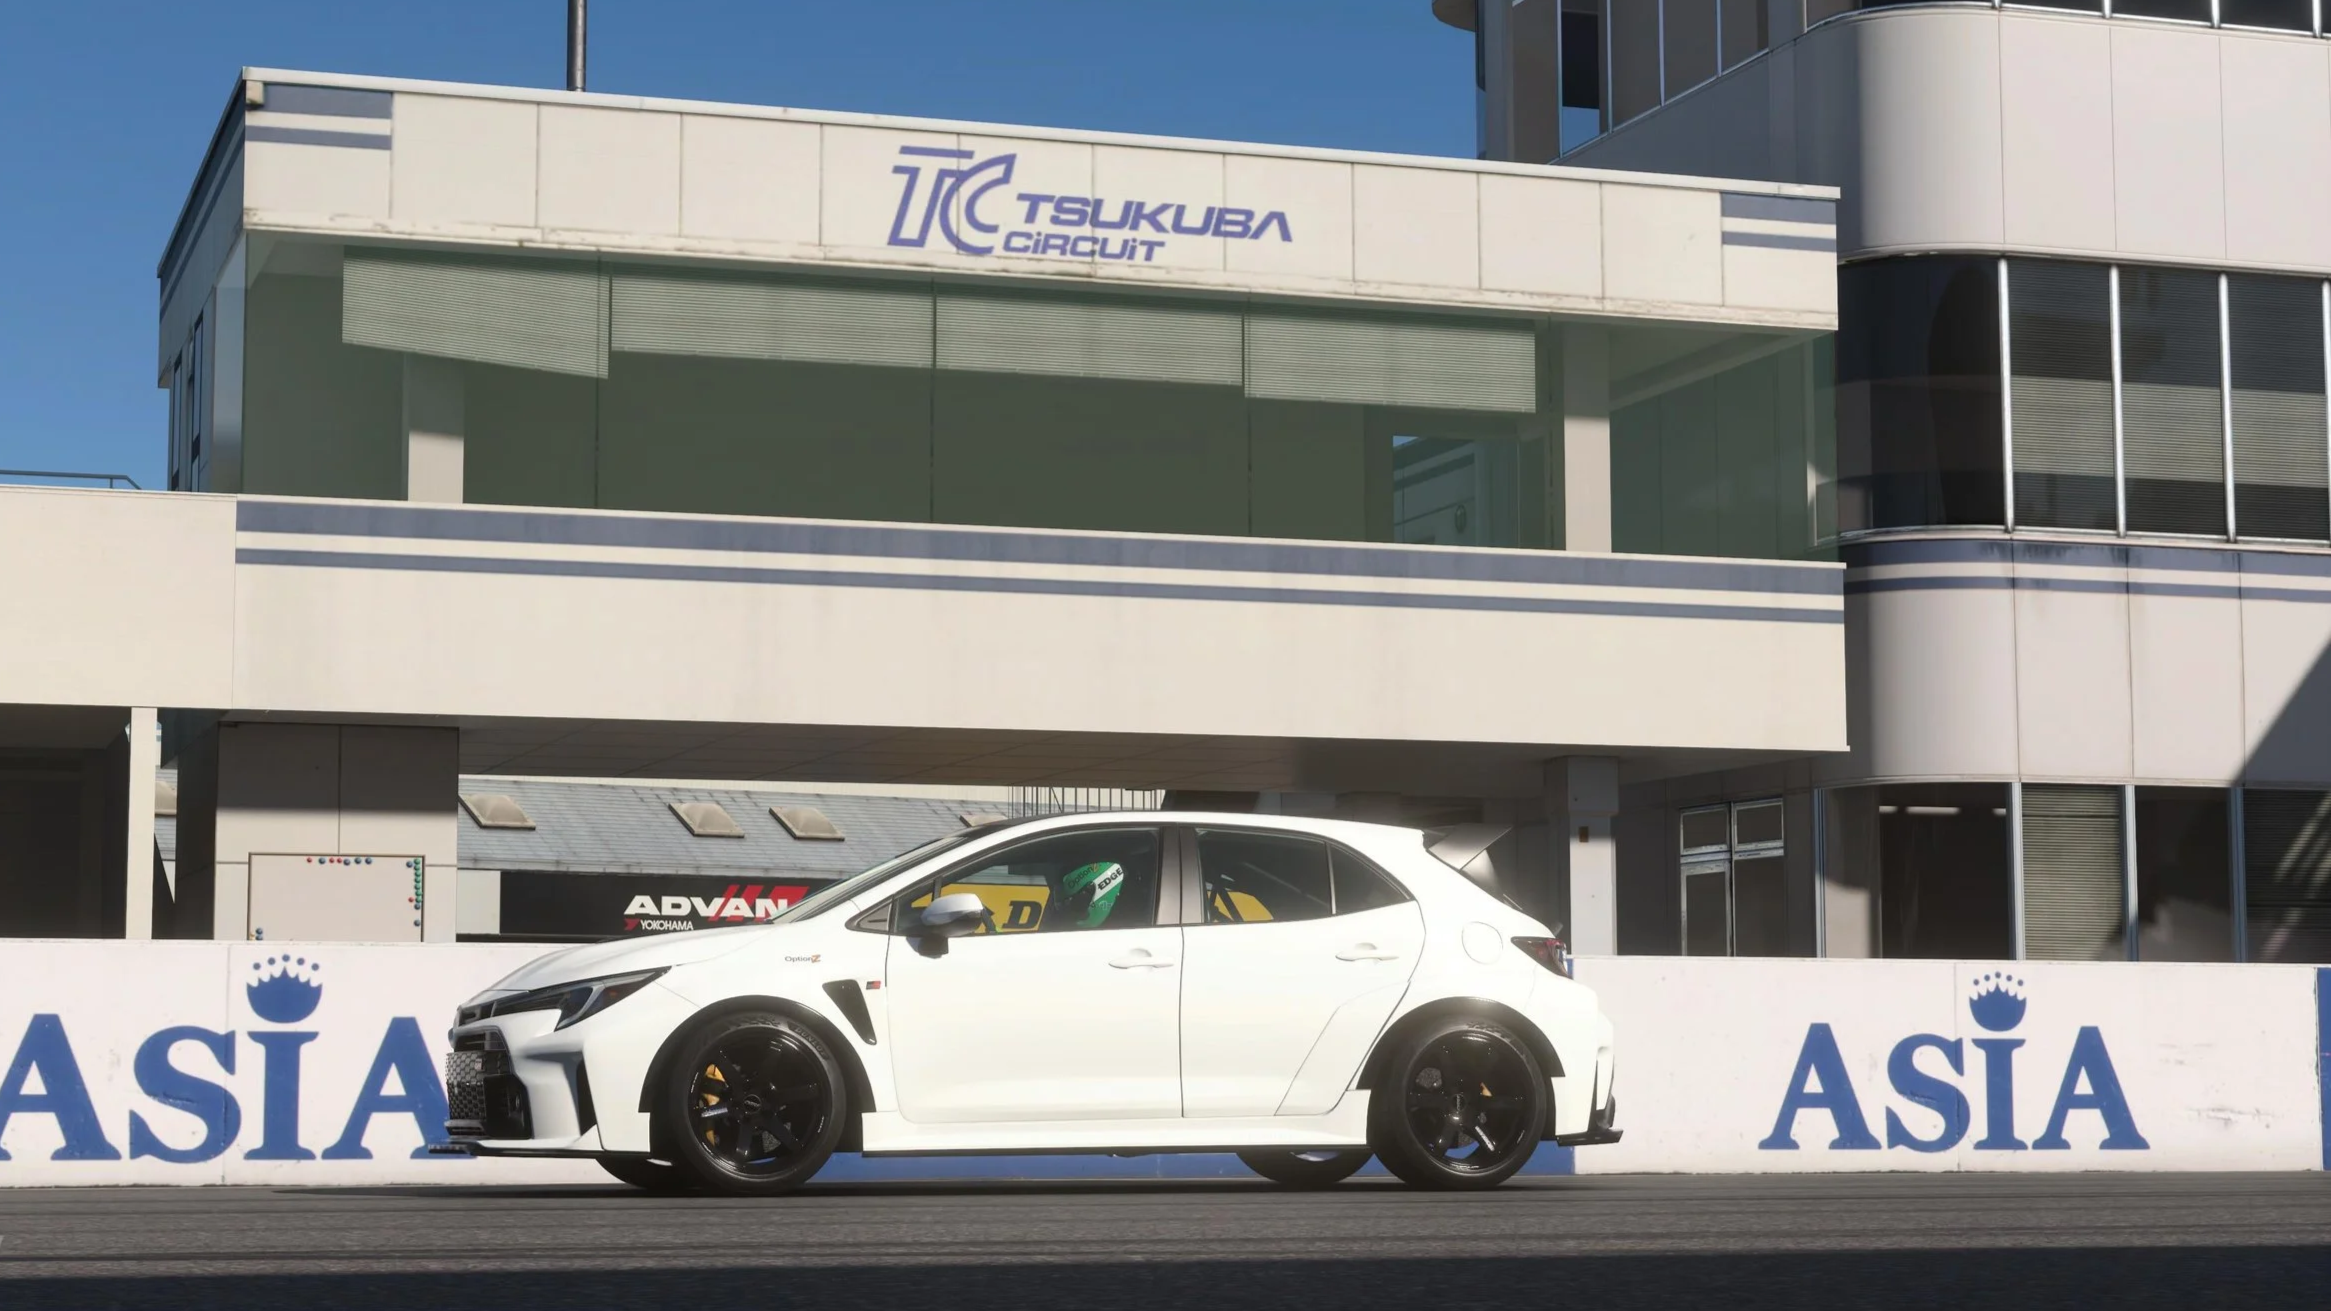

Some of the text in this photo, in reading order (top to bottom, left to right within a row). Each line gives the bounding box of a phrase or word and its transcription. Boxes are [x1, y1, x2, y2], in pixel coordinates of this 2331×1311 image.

[1016, 193, 1293, 242] TSUKUBA
[1098, 868, 1123, 890] EDGE
[623, 895, 788, 919] ADVAN
[640, 919, 694, 931] YOKOHAMA
[1758, 1023, 2151, 1153] ASIA
